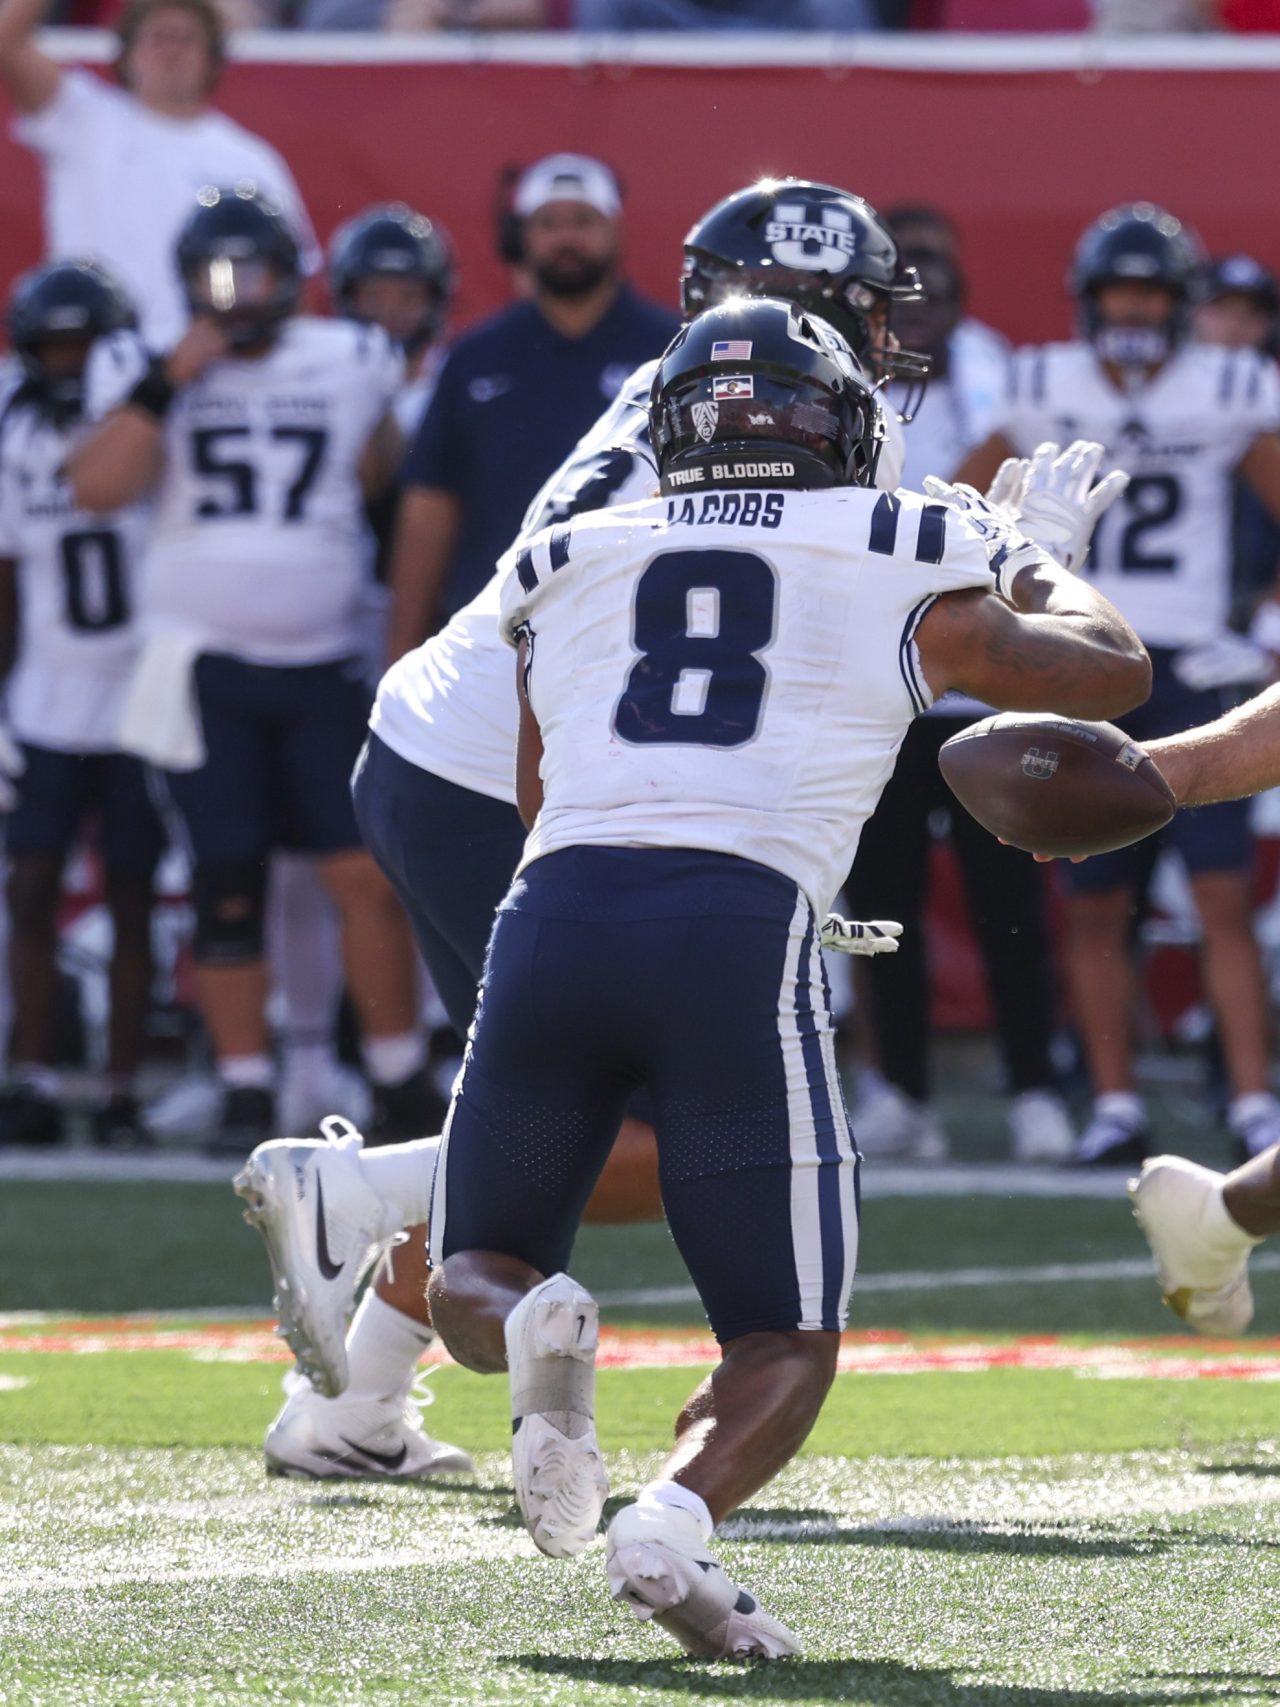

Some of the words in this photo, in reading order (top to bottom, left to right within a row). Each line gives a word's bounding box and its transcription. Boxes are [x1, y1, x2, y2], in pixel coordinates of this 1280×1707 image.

[765, 221, 857, 257] STATE
[772, 204, 852, 273] U
[193, 425, 328, 521] 57
[667, 467, 705, 487] TRUE
[712, 462, 795, 480] BLOODED
[62, 529, 131, 633] 0
[609, 544, 781, 752] 8
